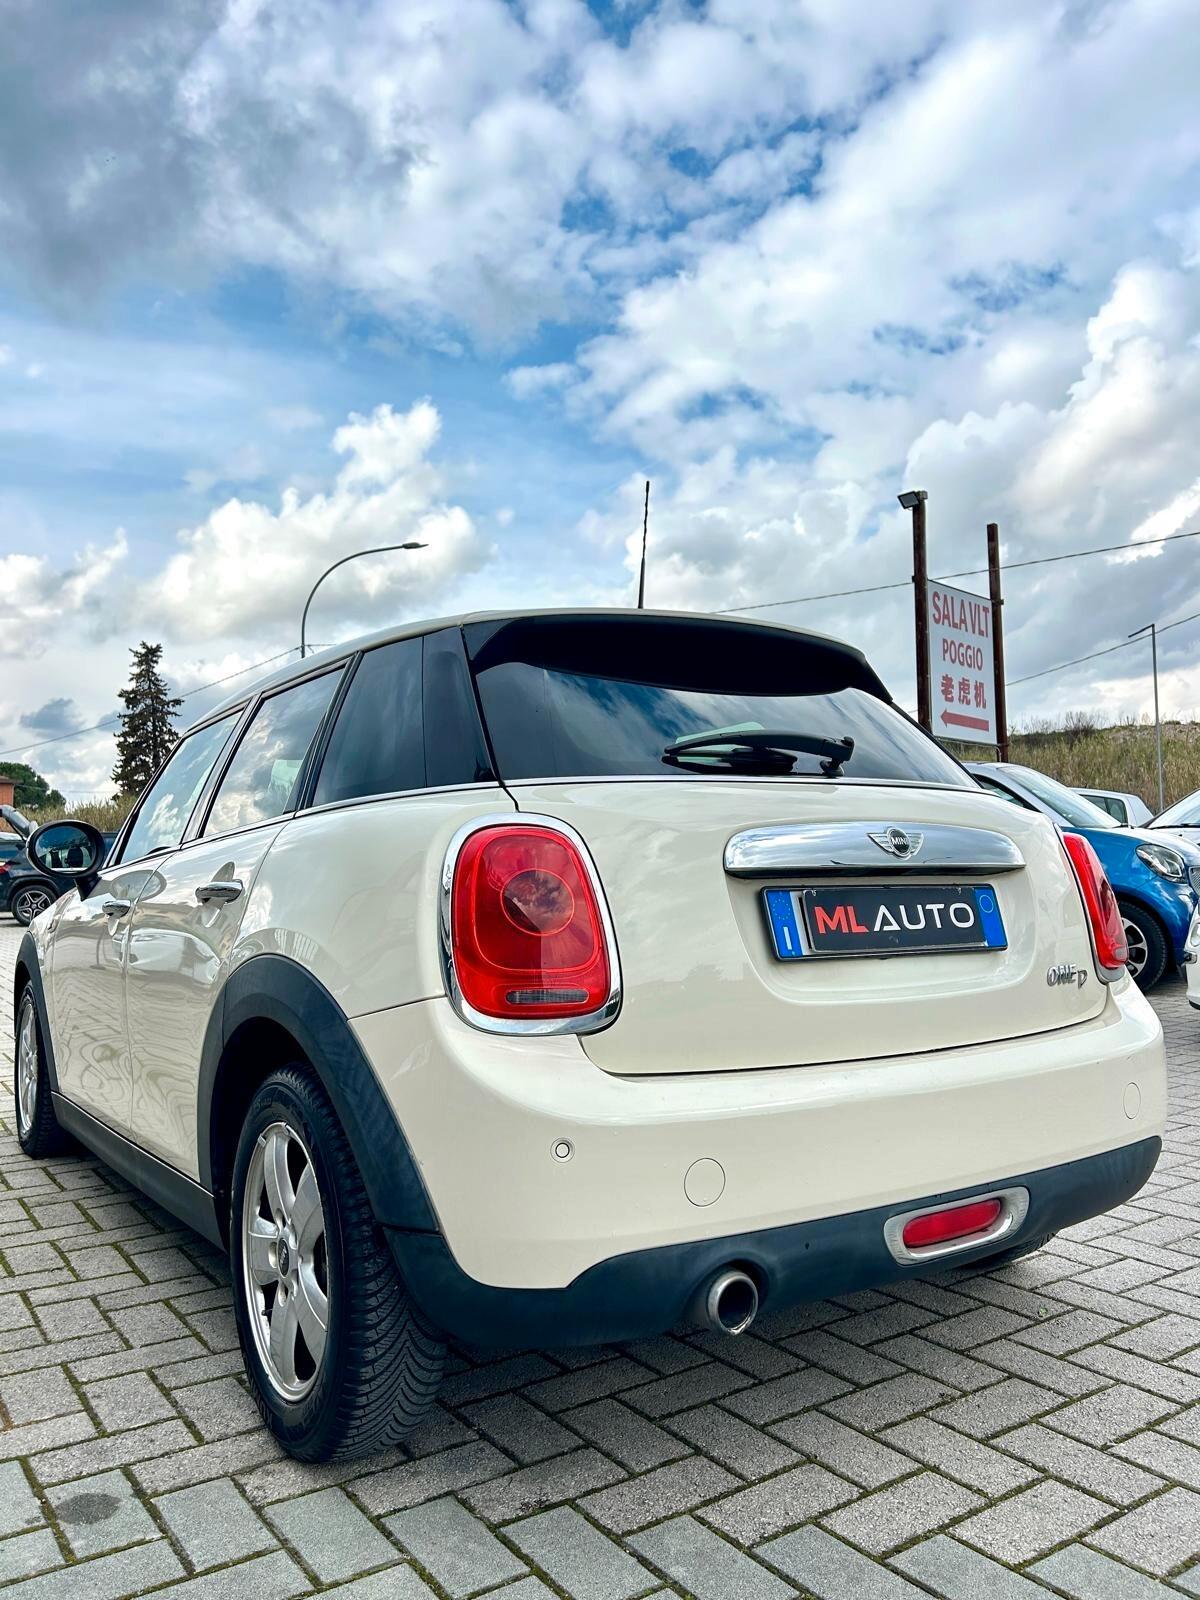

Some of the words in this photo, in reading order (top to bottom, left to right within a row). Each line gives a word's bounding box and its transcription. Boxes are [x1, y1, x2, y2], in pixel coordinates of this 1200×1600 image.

[932, 591, 968, 632] SALA
[968, 601, 990, 638] VLT
[942, 638, 983, 671] POGGIO
[940, 674, 987, 709] 老虎机
[890, 836, 907, 845] MINI
[814, 905, 869, 934] ML
[873, 902, 975, 932] AUTO
[1046, 964, 1077, 987] ONE
